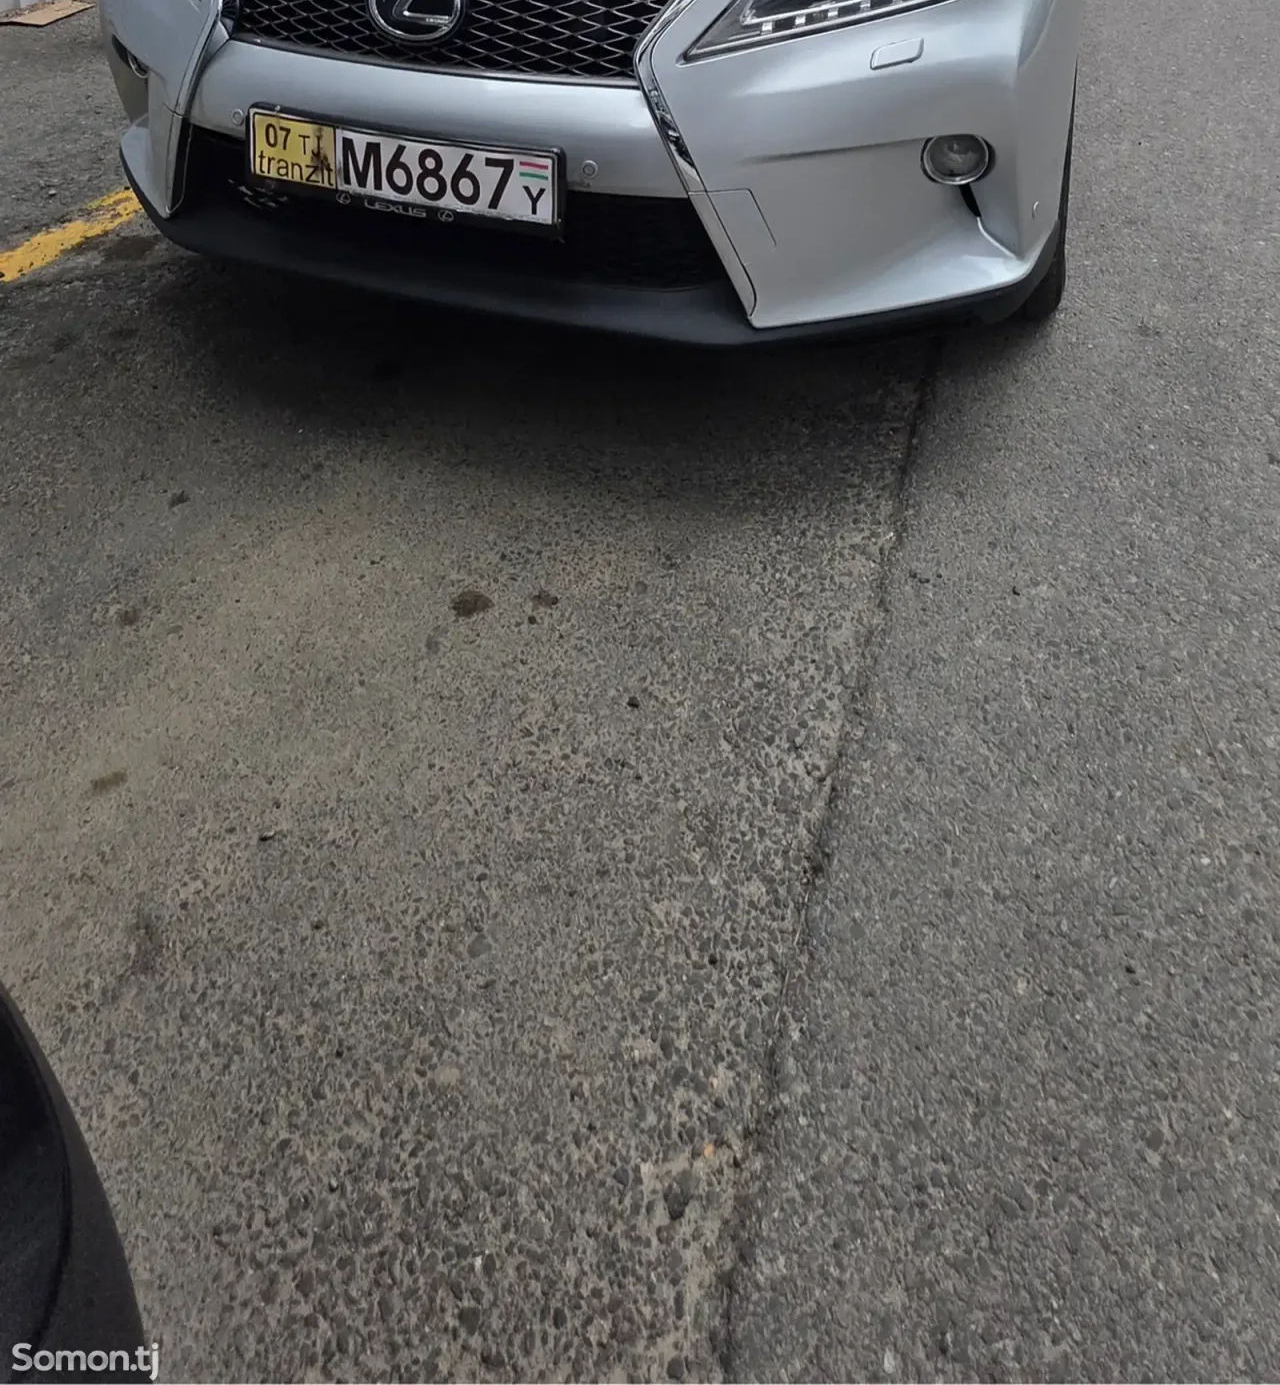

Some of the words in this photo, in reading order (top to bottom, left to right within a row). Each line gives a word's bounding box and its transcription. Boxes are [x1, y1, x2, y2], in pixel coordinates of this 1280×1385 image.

[265, 123, 291, 151] 07
[298, 134, 321, 157] TJ
[258, 149, 334, 187] tranzit
[342, 137, 515, 210] M6867
[522, 185, 546, 215] Y
[364, 198, 427, 218] LEXUS
